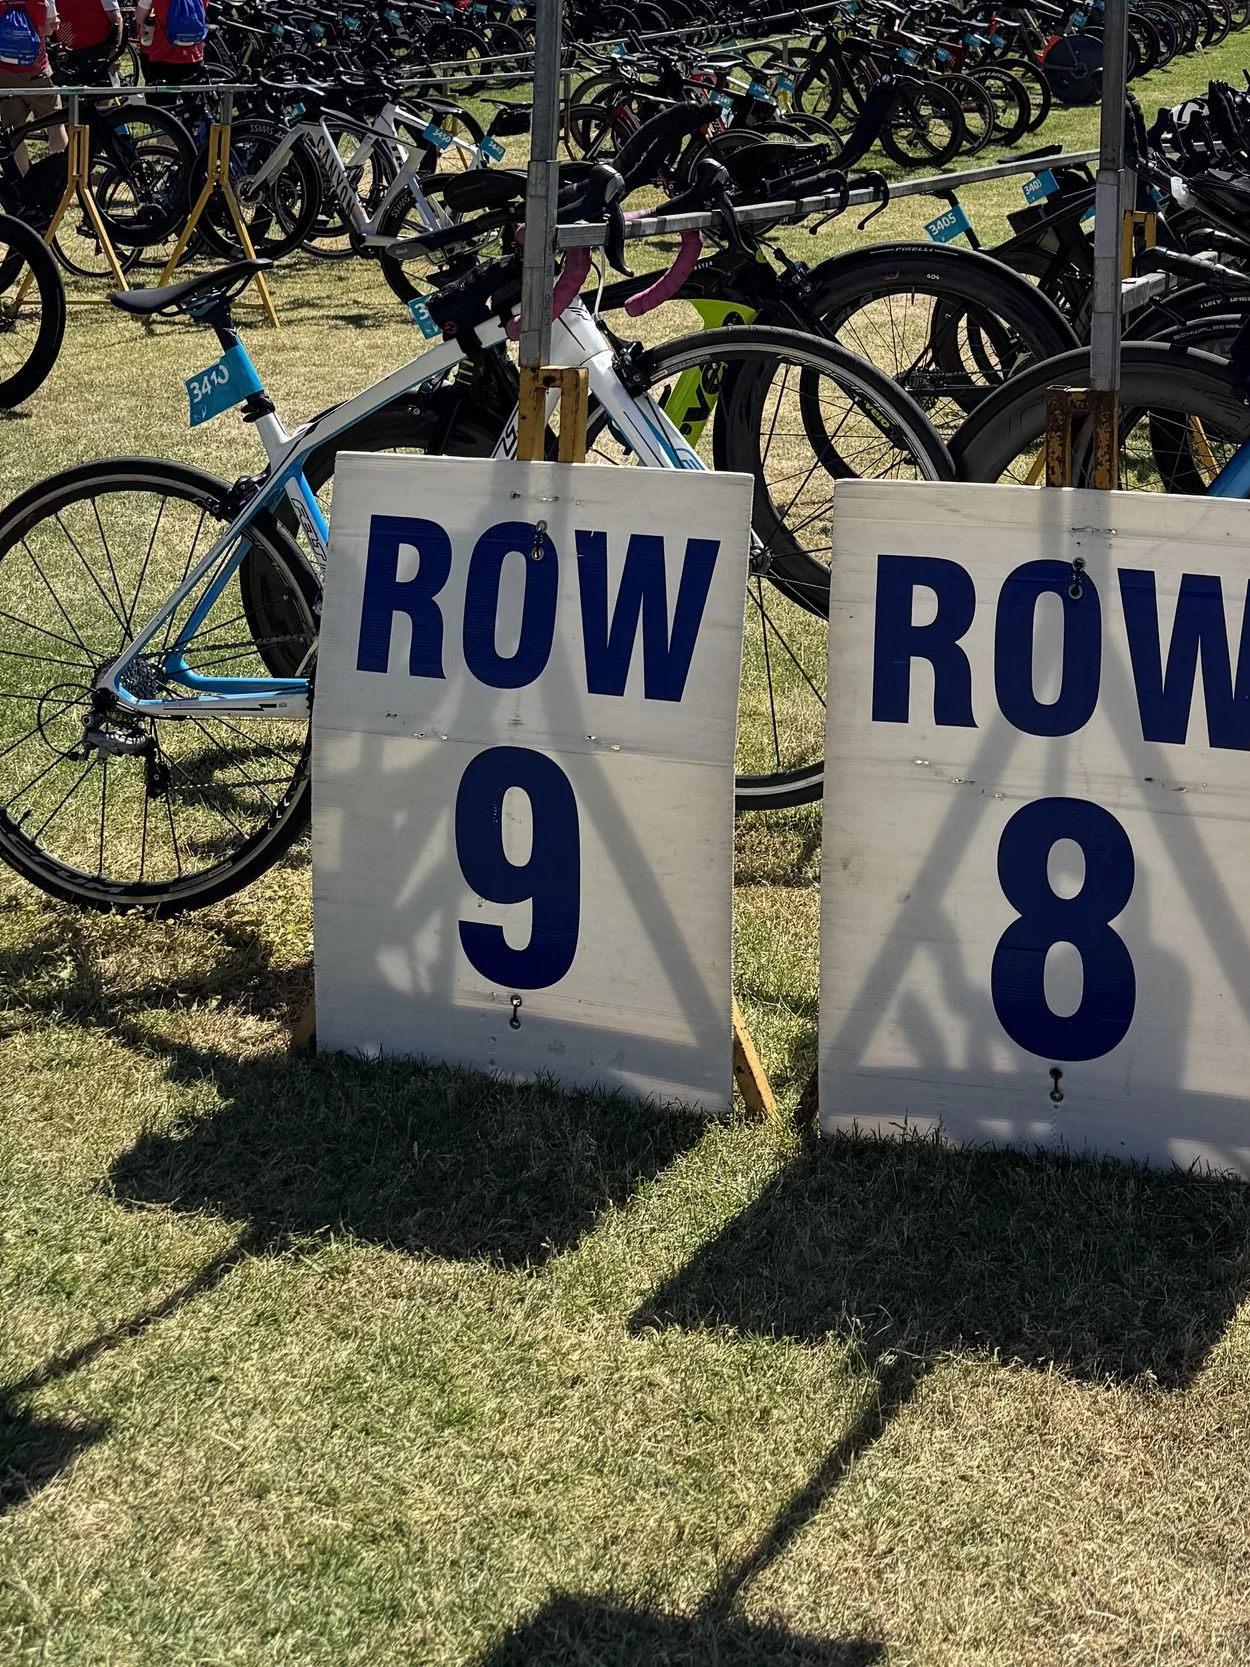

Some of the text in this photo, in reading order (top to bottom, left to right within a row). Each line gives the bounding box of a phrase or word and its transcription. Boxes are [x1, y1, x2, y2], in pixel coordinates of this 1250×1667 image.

[433, 127, 451, 143] 3450
[928, 212, 957, 236] 3405
[356, 513, 721, 703] ROW
[454, 745, 581, 990] 9
[990, 796, 1136, 1062] 8
